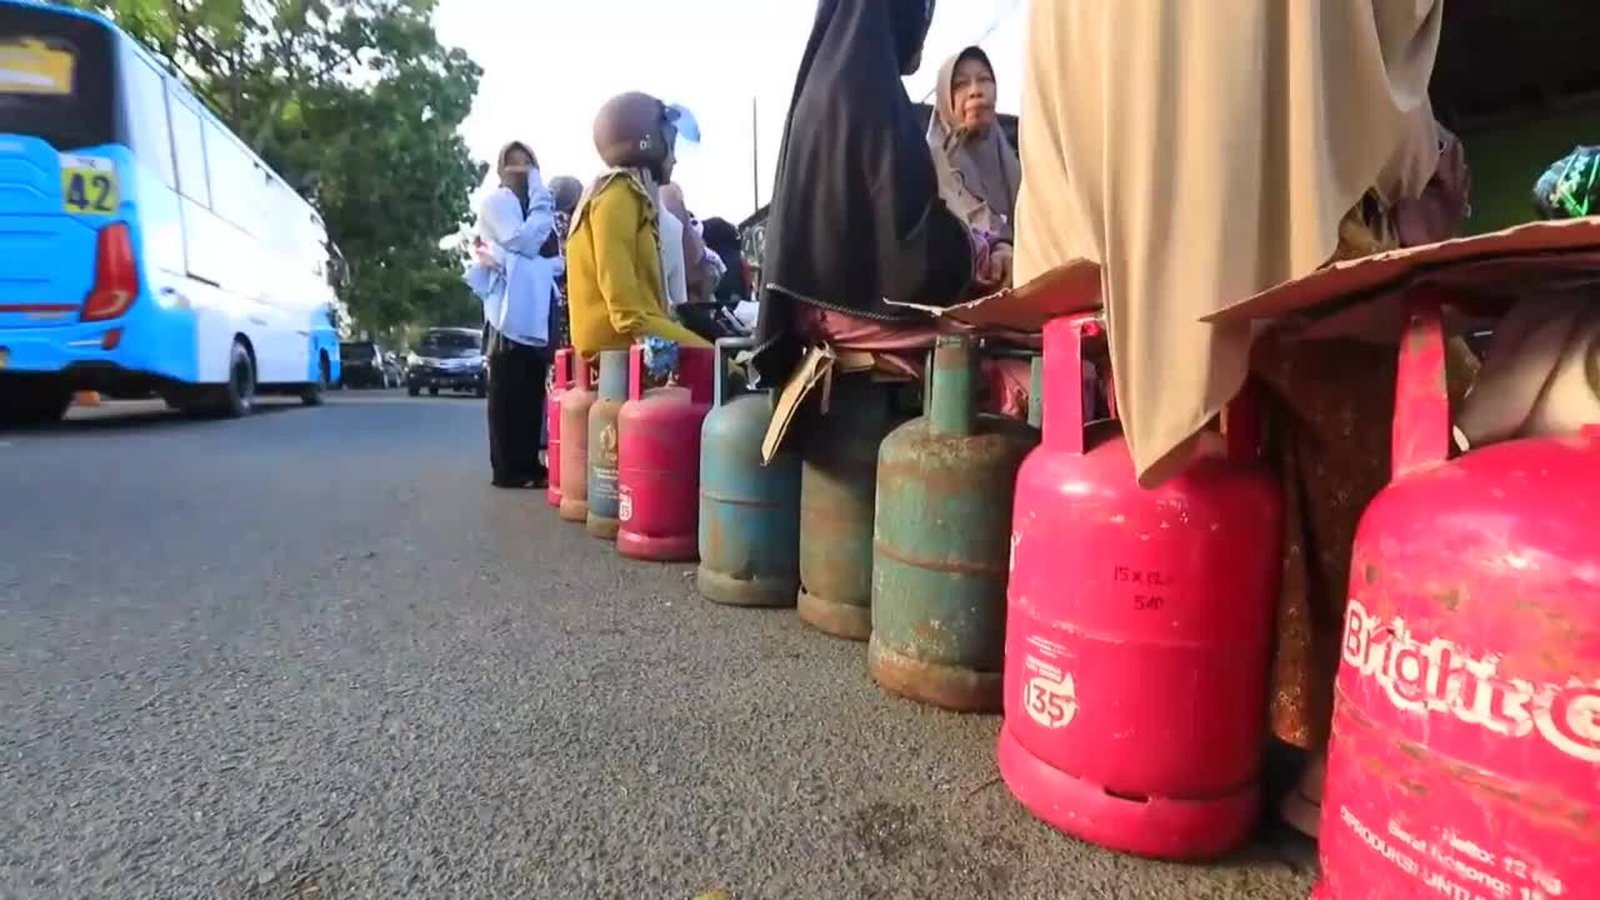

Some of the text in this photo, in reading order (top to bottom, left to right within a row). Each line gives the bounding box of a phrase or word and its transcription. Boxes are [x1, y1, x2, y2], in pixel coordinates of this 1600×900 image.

[67, 172, 111, 212] 42
[1343, 599, 1533, 737] Bright
[1026, 680, 1066, 723] 135
[1504, 855, 1529, 879] 12
